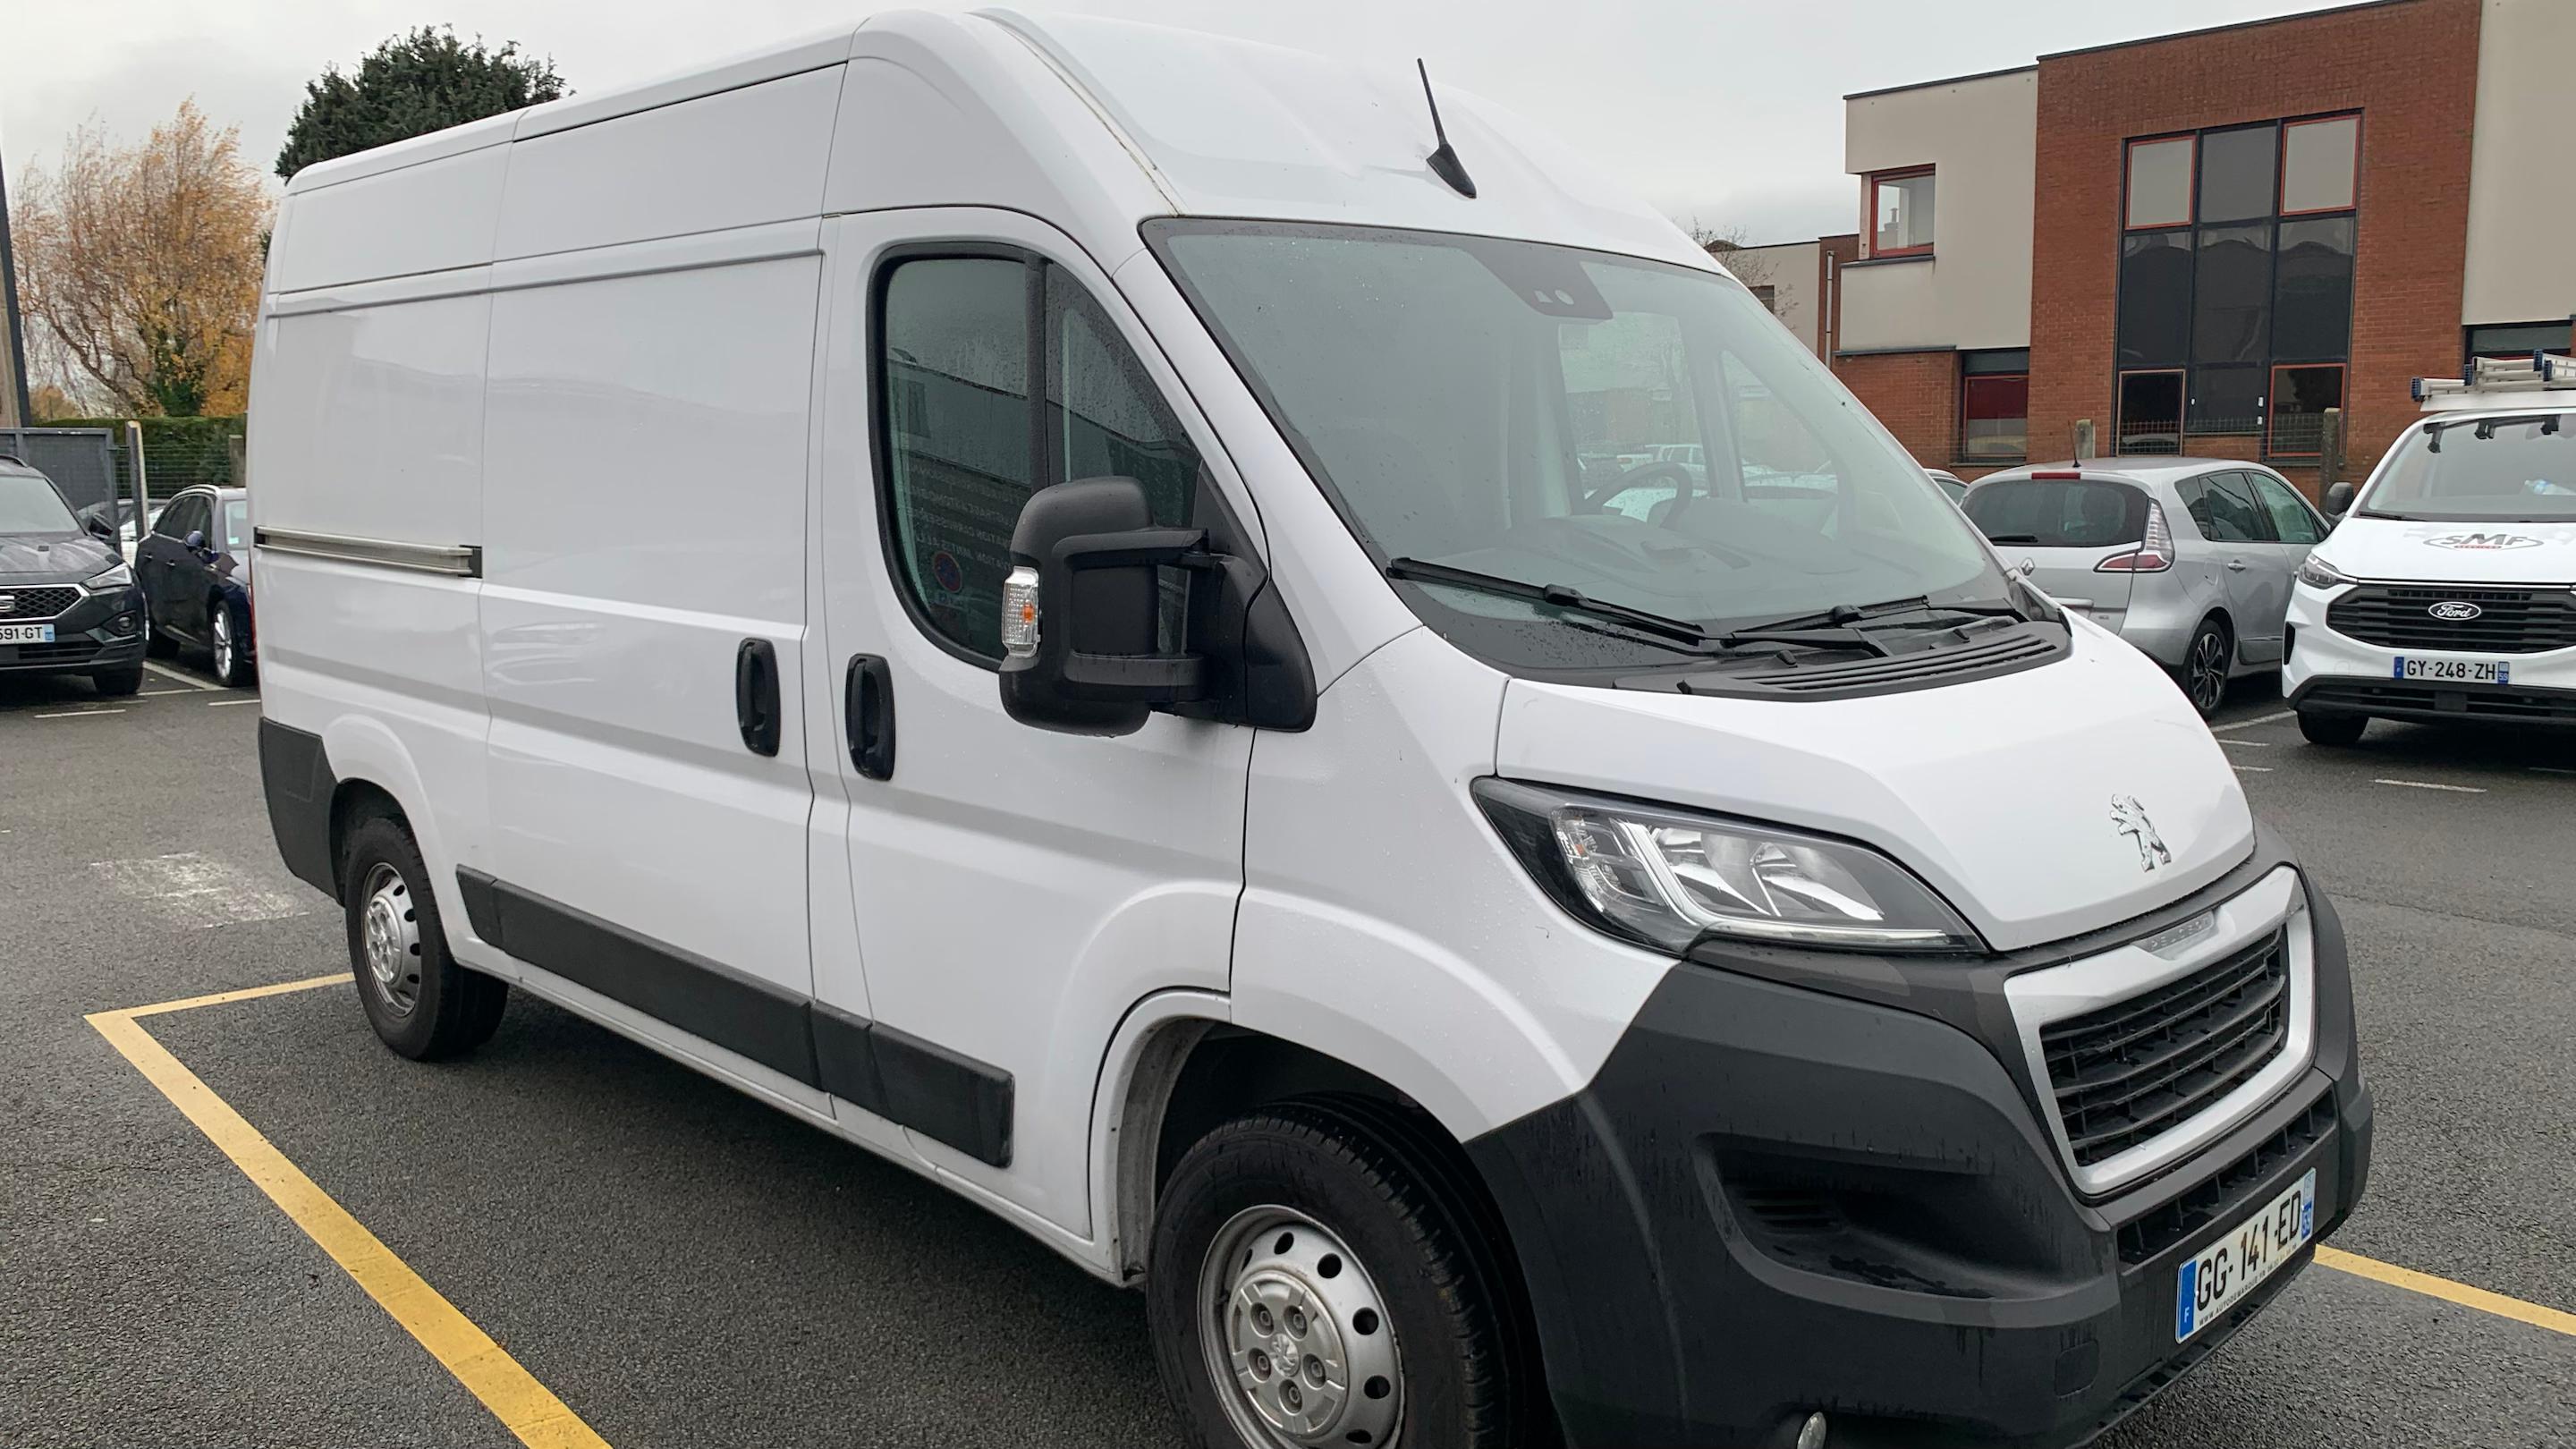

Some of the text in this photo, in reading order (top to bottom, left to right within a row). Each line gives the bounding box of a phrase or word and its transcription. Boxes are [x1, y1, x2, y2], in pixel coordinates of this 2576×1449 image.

[2440, 533, 2528, 546] SMF
[2436, 604, 2472, 618] Ford
[2406, 660, 2496, 680] GY-248-ZH
[2183, 1306, 2190, 1324] F
[2197, 1190, 2301, 1312] GG-141-ED
